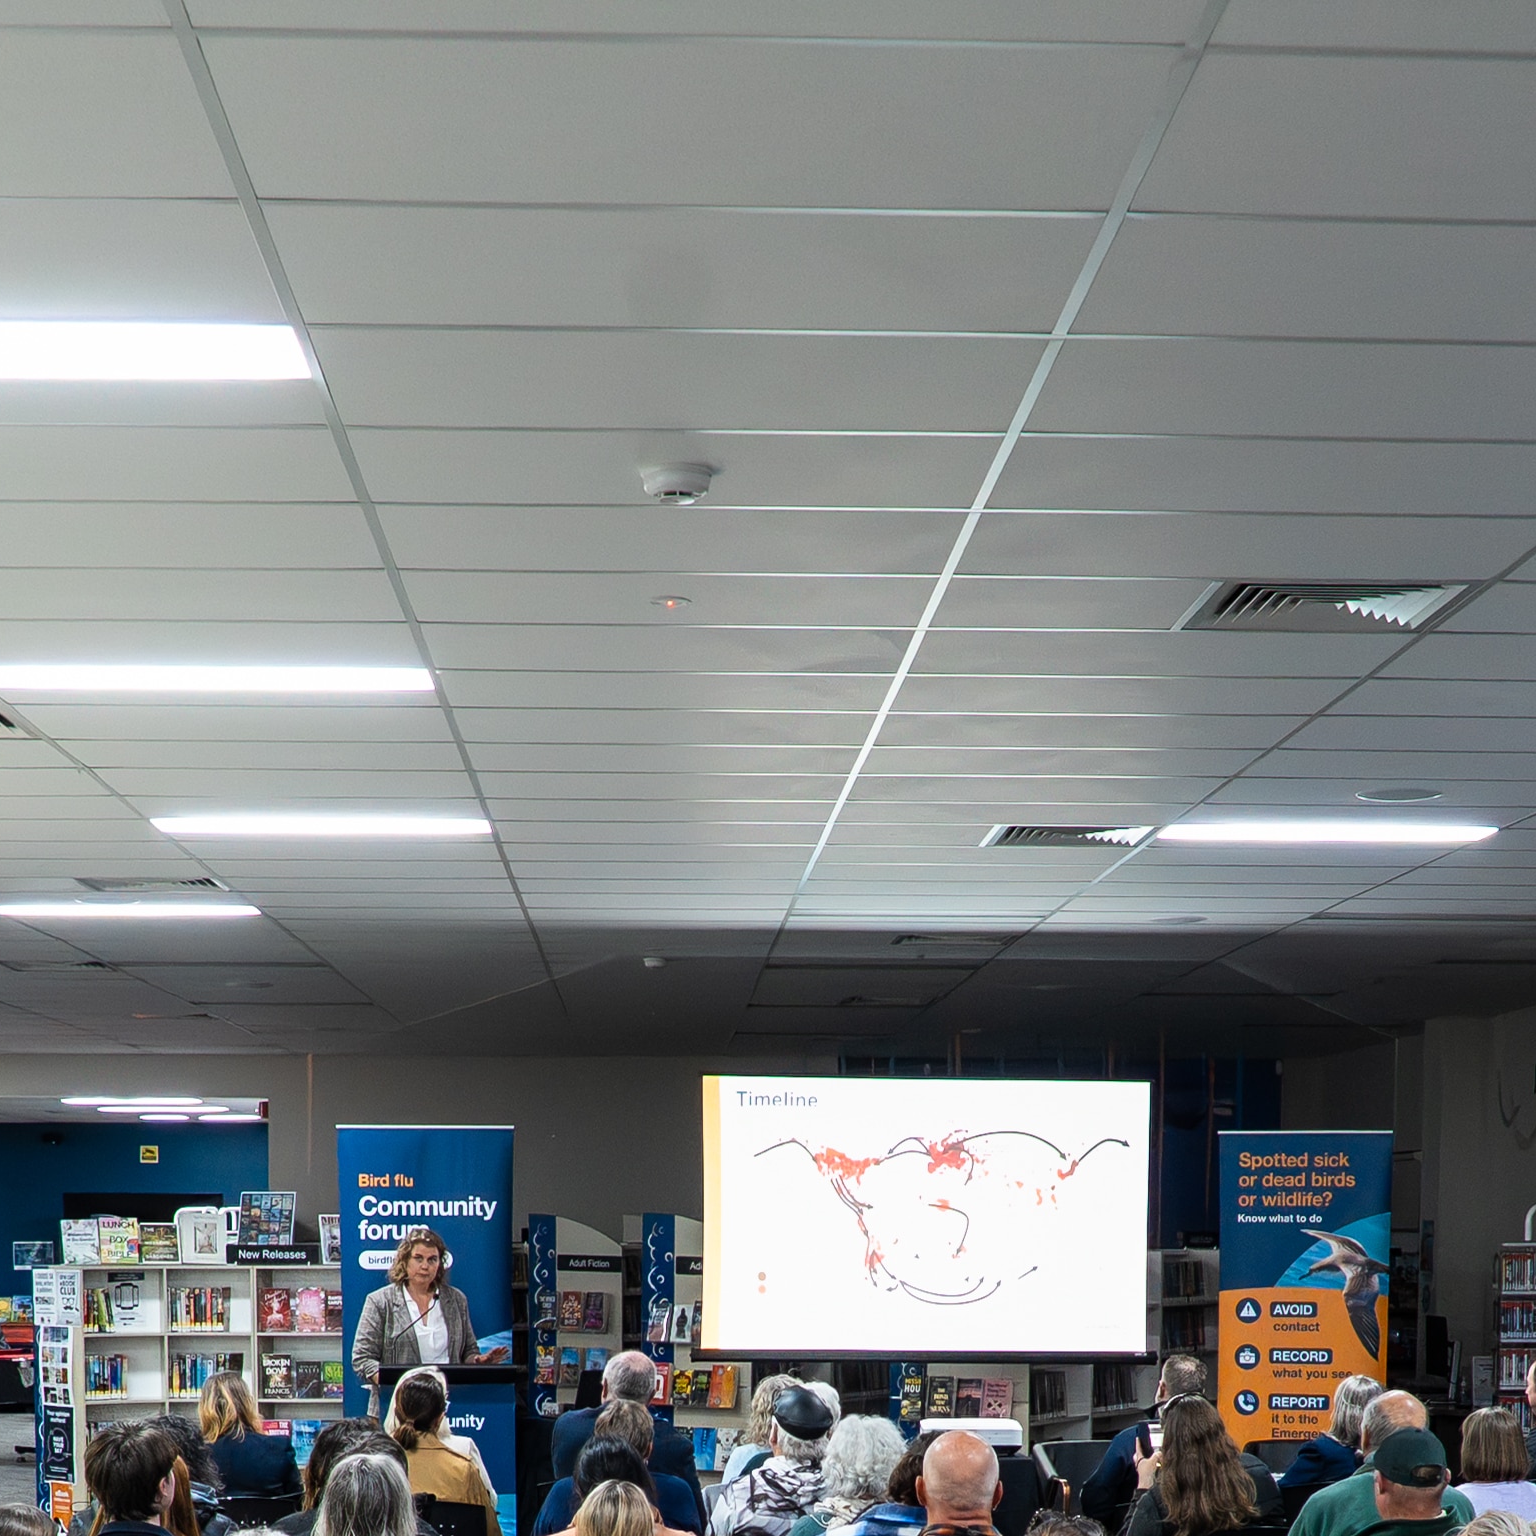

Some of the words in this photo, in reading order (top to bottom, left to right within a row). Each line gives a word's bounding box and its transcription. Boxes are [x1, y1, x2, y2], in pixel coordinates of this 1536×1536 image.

[736, 1090, 818, 1107] Timeline
[1239, 1152, 1308, 1170] Spotted
[1314, 1152, 1350, 1167] sick
[358, 1173, 389, 1187] Bird
[394, 1173, 414, 1187] flu
[1238, 1175, 1257, 1187] or
[1262, 1172, 1305, 1187] dead
[1312, 1172, 1356, 1187] birds
[1238, 1195, 1257, 1207] or
[1262, 1191, 1333, 1207] wildlife?
[358, 1195, 497, 1221] Community
[1237, 1213, 1266, 1223] Know
[1269, 1213, 1294, 1223] what
[1296, 1214, 1306, 1223] to
[1309, 1213, 1322, 1223] do
[102, 1221, 134, 1229] LUNCH
[110, 1235, 128, 1244] BOX
[238, 1249, 260, 1259] New
[262, 1249, 307, 1260] Releases
[368, 1255, 395, 1265] birdfl
[587, 1258, 610, 1268] Fiction
[1273, 1304, 1313, 1315] AVOID
[1273, 1322, 1320, 1332] contact
[1273, 1351, 1328, 1362] RECORD
[1272, 1368, 1302, 1378] what
[1306, 1369, 1327, 1380] you
[1271, 1397, 1325, 1408] REPORT
[1272, 1413, 1279, 1423] it
[1283, 1414, 1295, 1424] to
[1299, 1413, 1318, 1424] the
